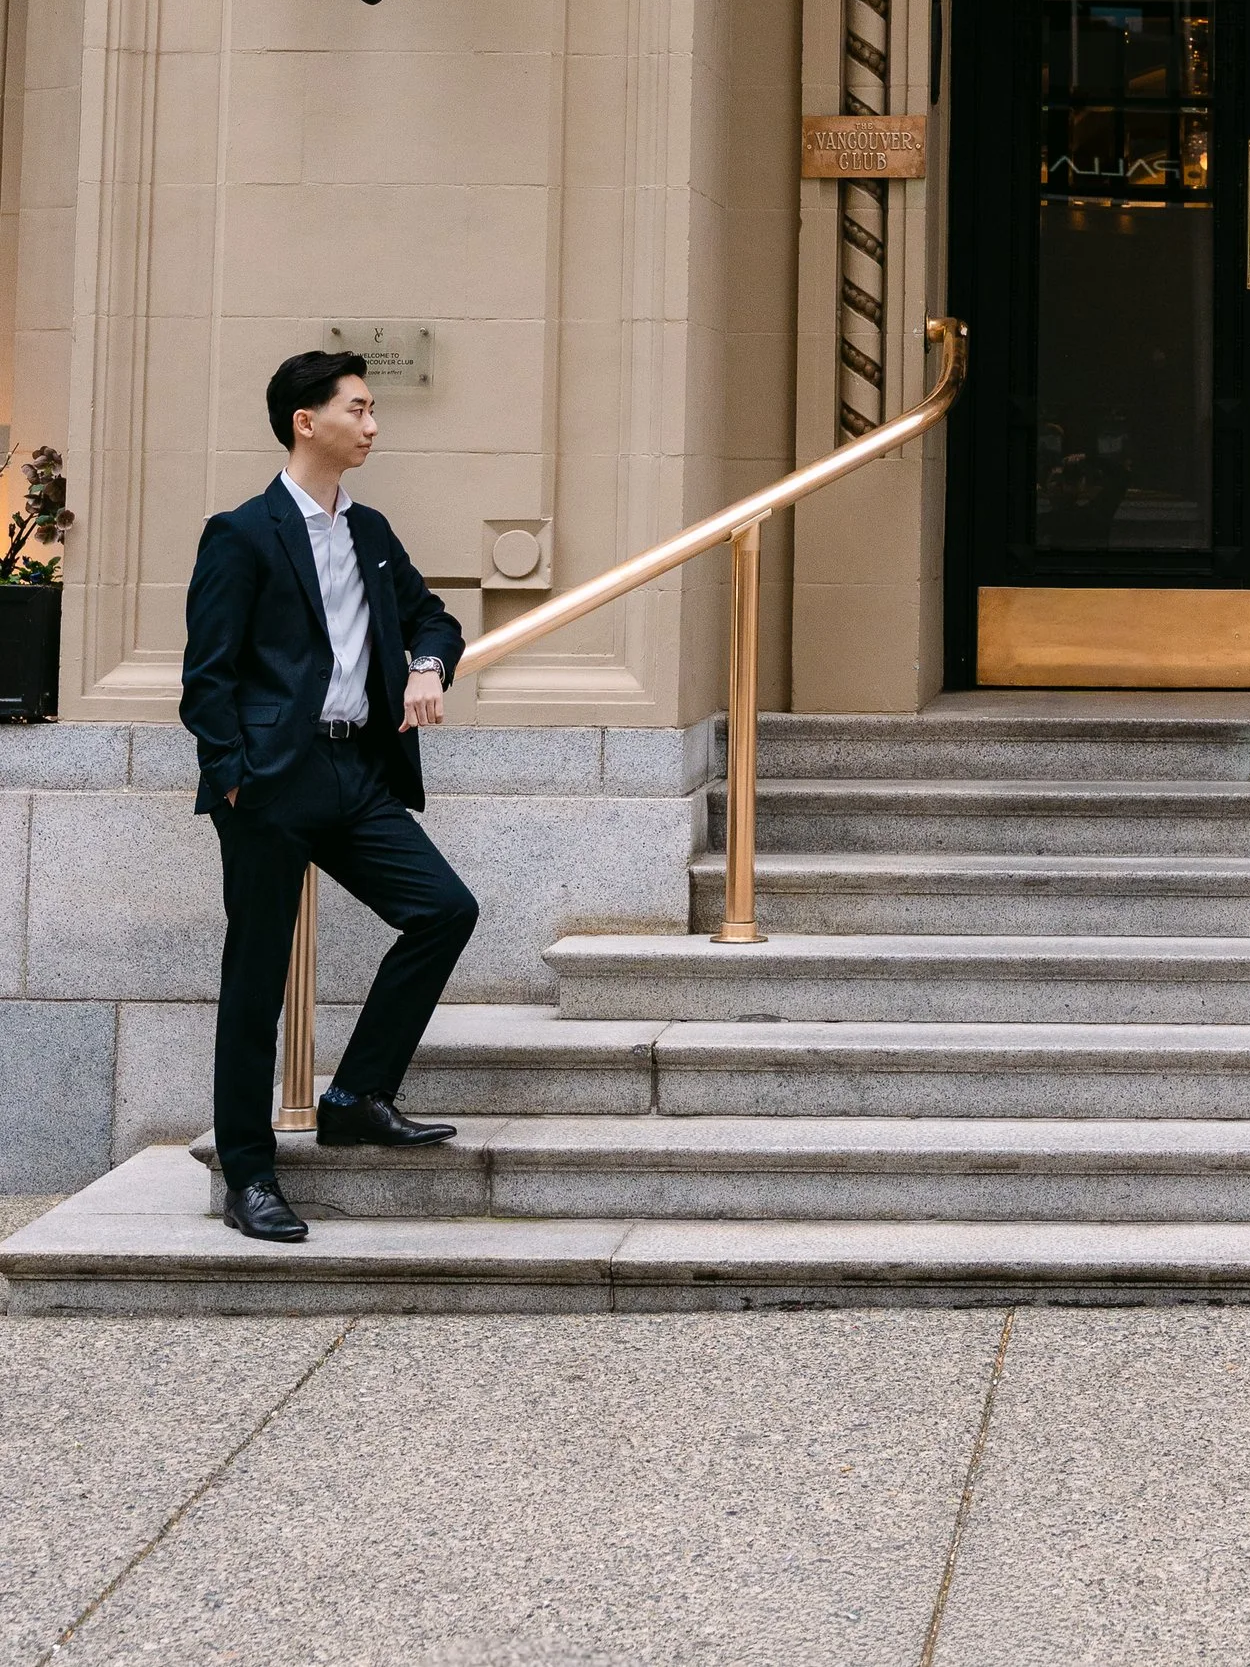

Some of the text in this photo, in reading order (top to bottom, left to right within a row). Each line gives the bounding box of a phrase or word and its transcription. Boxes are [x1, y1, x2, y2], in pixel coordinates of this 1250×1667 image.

[855, 122, 874, 130] THE
[815, 132, 914, 151] VANCOUVER
[838, 152, 888, 170] CLUB
